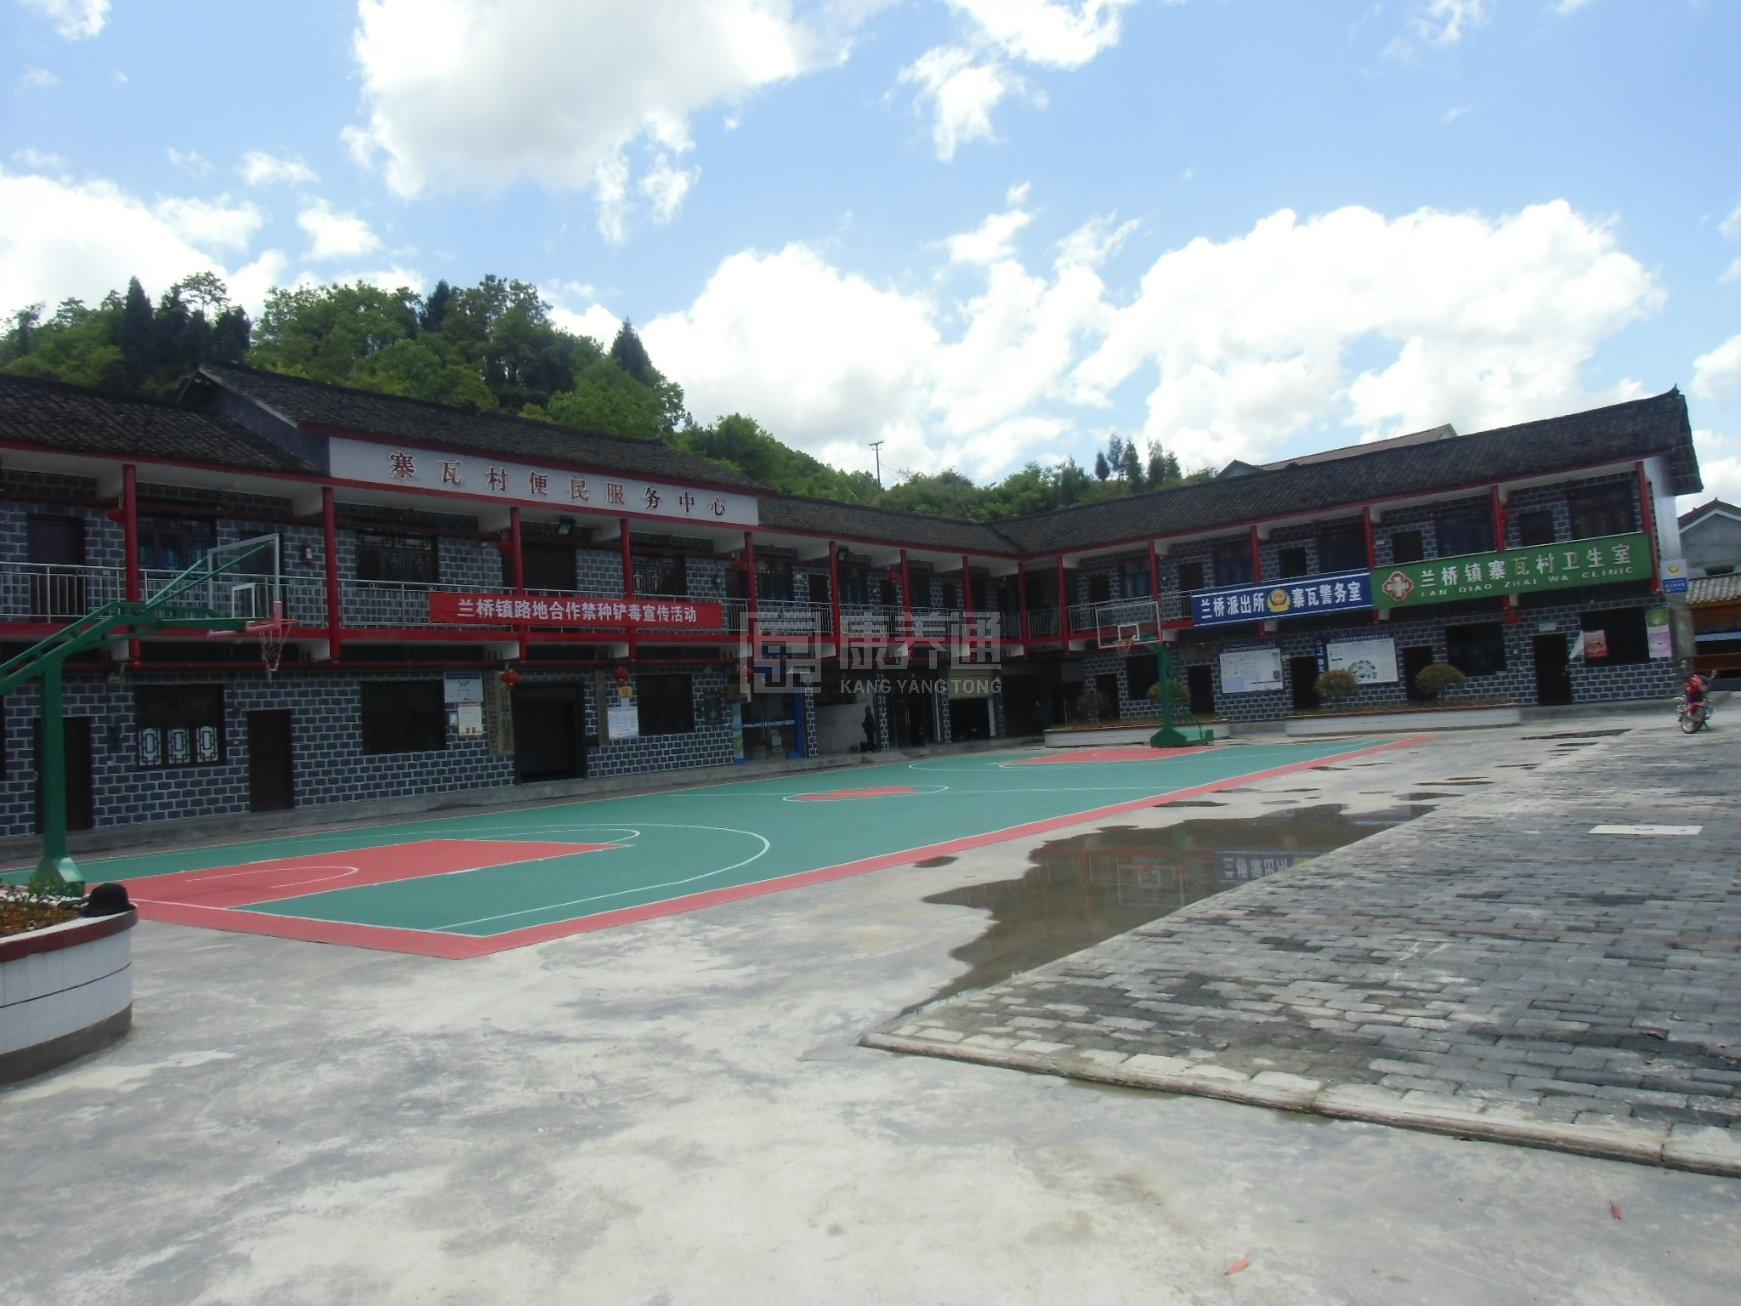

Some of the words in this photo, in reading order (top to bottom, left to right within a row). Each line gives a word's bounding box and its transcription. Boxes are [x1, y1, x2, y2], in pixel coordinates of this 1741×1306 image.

[388, 450, 726, 518] 寨瓦村便民服务中心
[1420, 543, 1632, 588] 兰桥镇寨瓦村卫生室
[1458, 583, 1493, 593] QIAO
[1548, 574, 1569, 583] WA
[1582, 566, 1633, 579] CLINIC
[457, 598, 697, 623] 兰桥镇路地合作禁种铲毒宣传活动
[1200, 592, 1265, 619] 兰桥派出所
[1291, 581, 1362, 608] 寨瓦警务室
